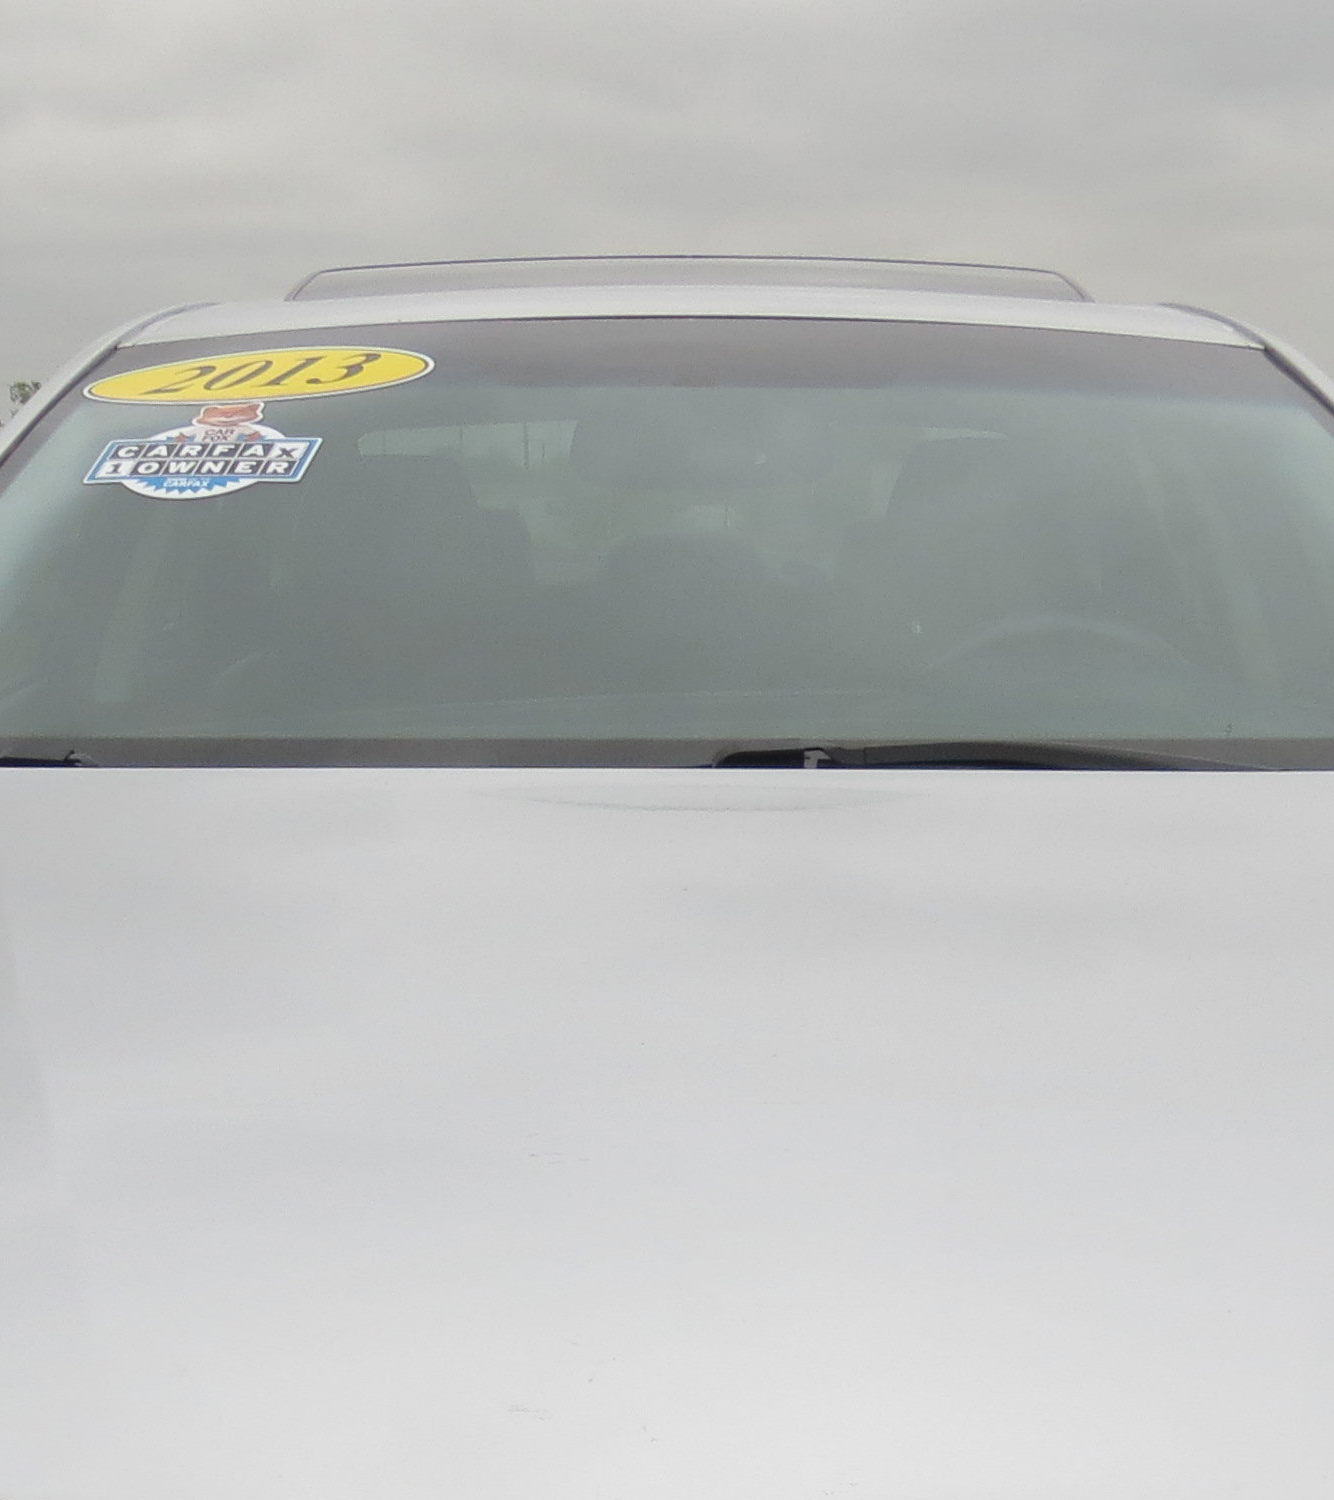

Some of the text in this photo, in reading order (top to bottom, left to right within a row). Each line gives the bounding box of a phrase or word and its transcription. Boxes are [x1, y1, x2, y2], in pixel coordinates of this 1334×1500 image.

[143, 352, 383, 396] 2013
[117, 442, 301, 460] CARFAX
[105, 460, 293, 475] 1 OWNER
